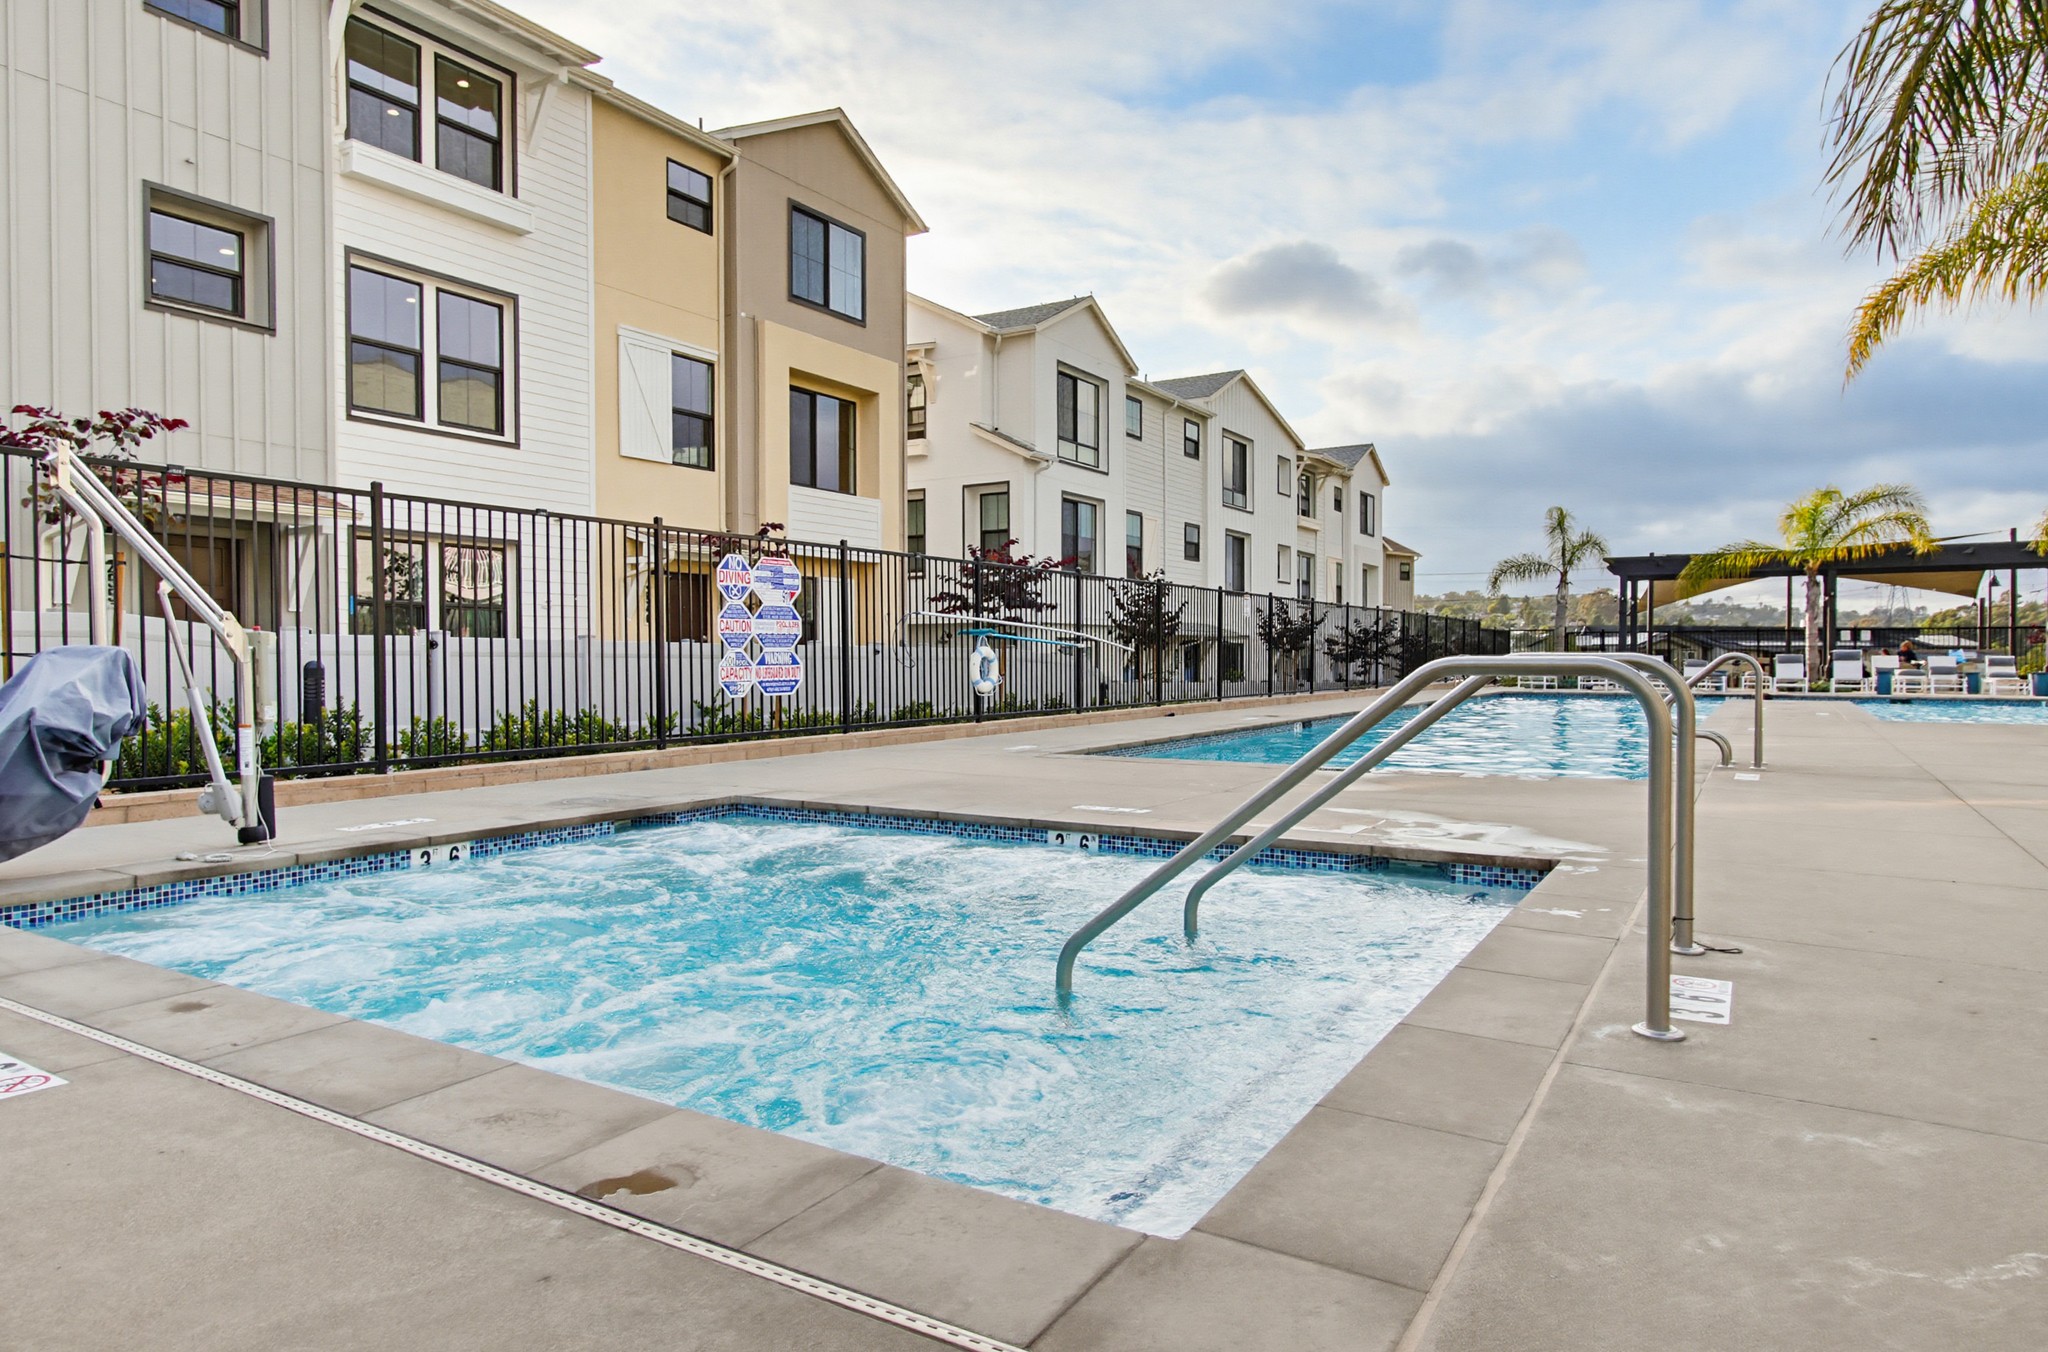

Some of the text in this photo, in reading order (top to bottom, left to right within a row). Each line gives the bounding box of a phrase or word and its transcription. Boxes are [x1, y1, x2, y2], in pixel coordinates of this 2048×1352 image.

[728, 556, 742, 570] NO
[719, 571, 751, 585] DIVING
[720, 619, 752, 633] CAUTION
[764, 652, 793, 665] WARNING
[720, 667, 752, 681] CAPACITY
[1080, 835, 1089, 849] 6
[420, 850, 431, 865] 3
[449, 846, 460, 861] 6
